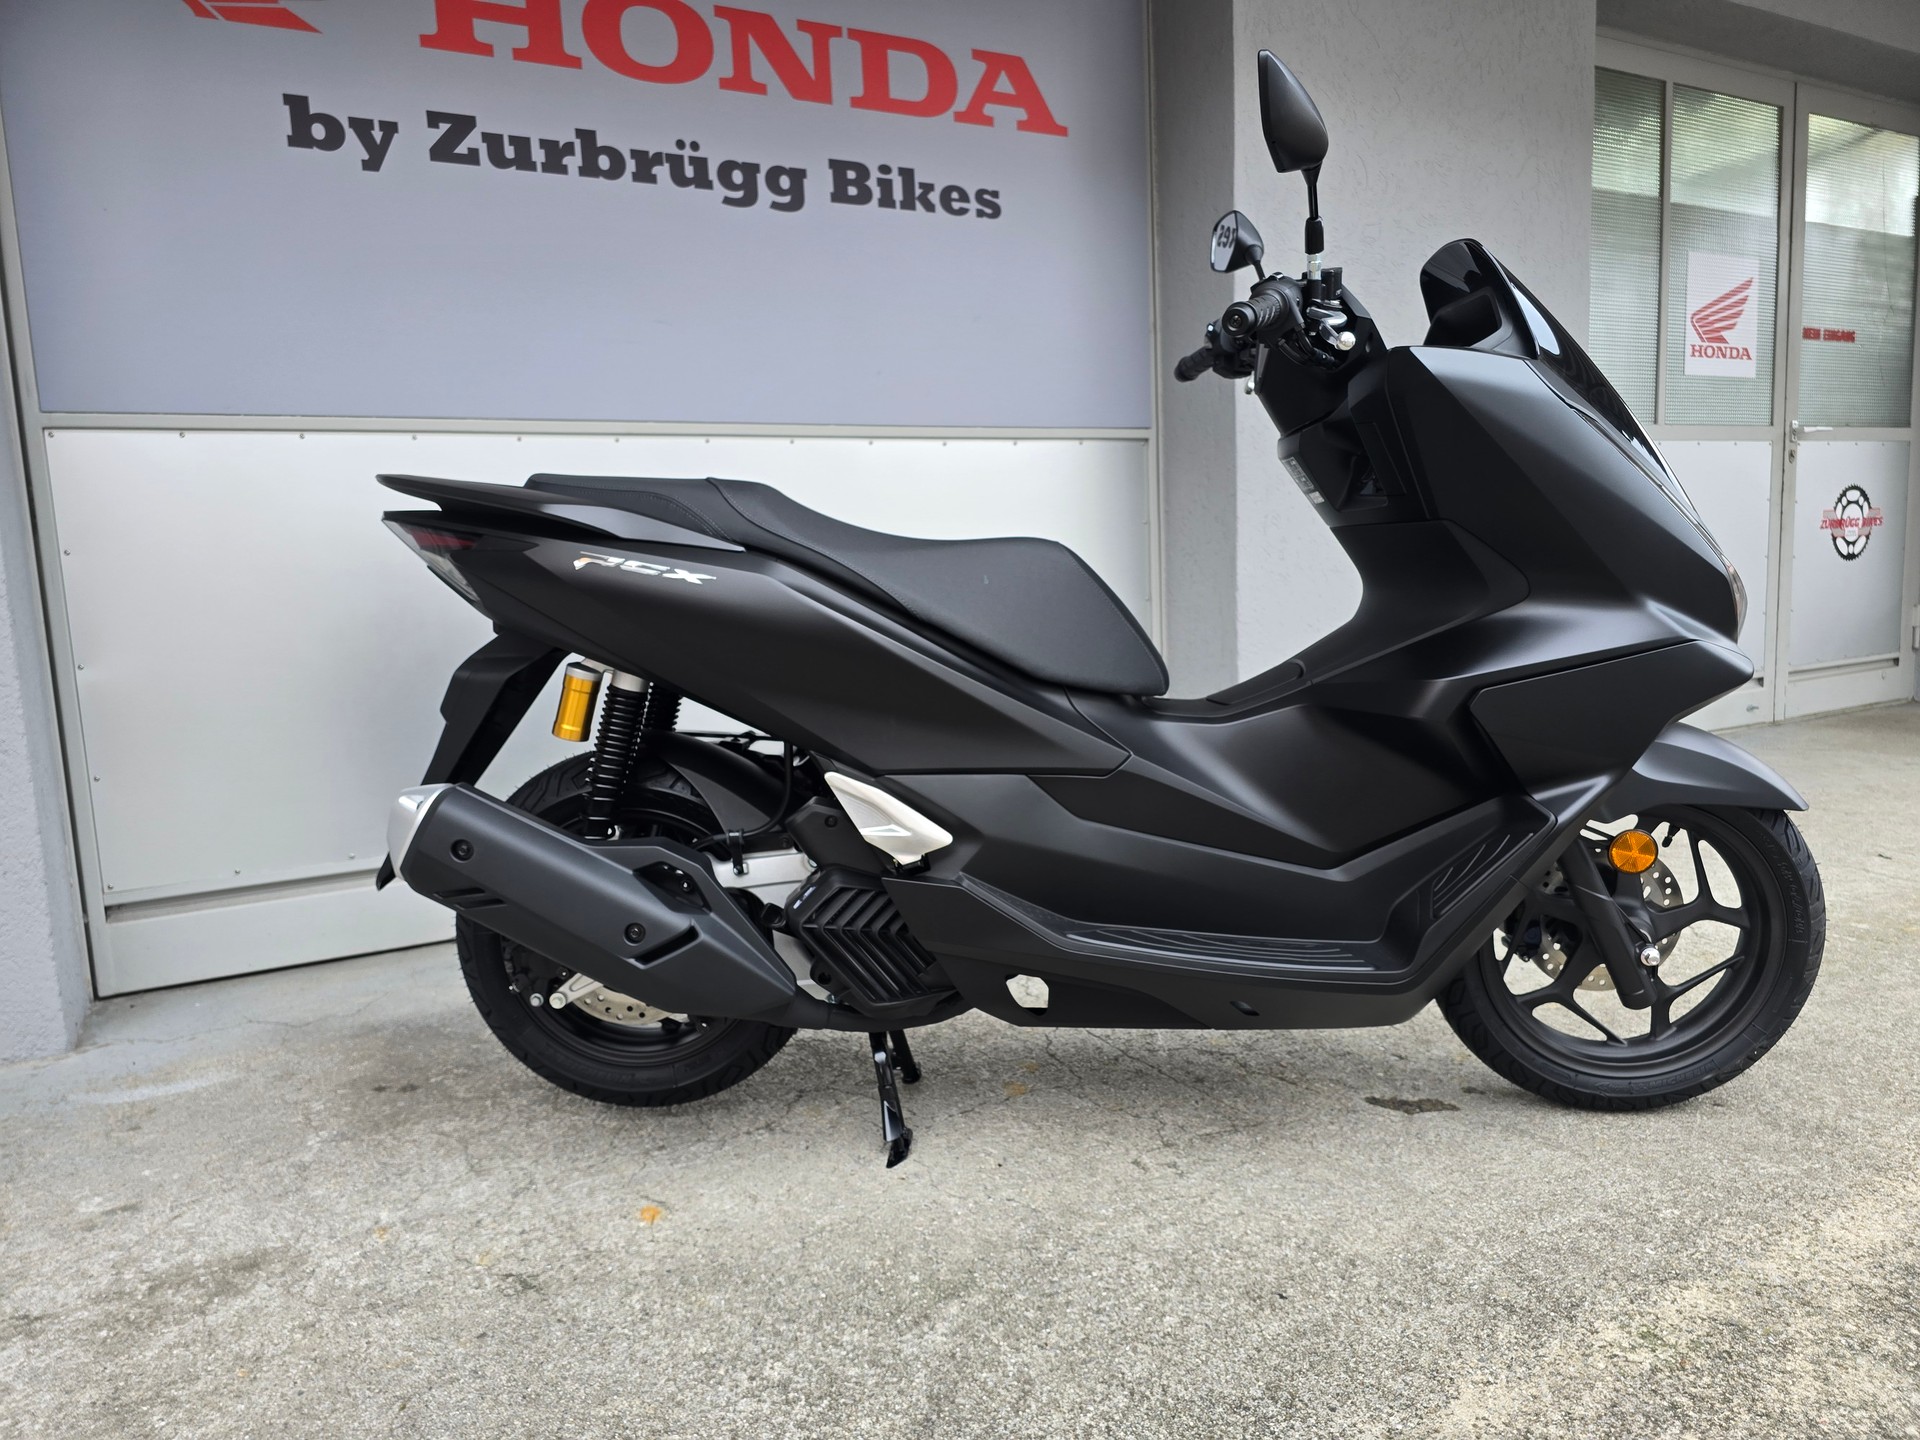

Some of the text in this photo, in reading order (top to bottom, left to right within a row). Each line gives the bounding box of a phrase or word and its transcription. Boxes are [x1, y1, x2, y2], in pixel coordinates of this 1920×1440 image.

[419, 0, 1069, 137] HONDA
[282, 93, 1001, 219] by Zurbrügg Bikes
[1690, 344, 1752, 361] HONDA
